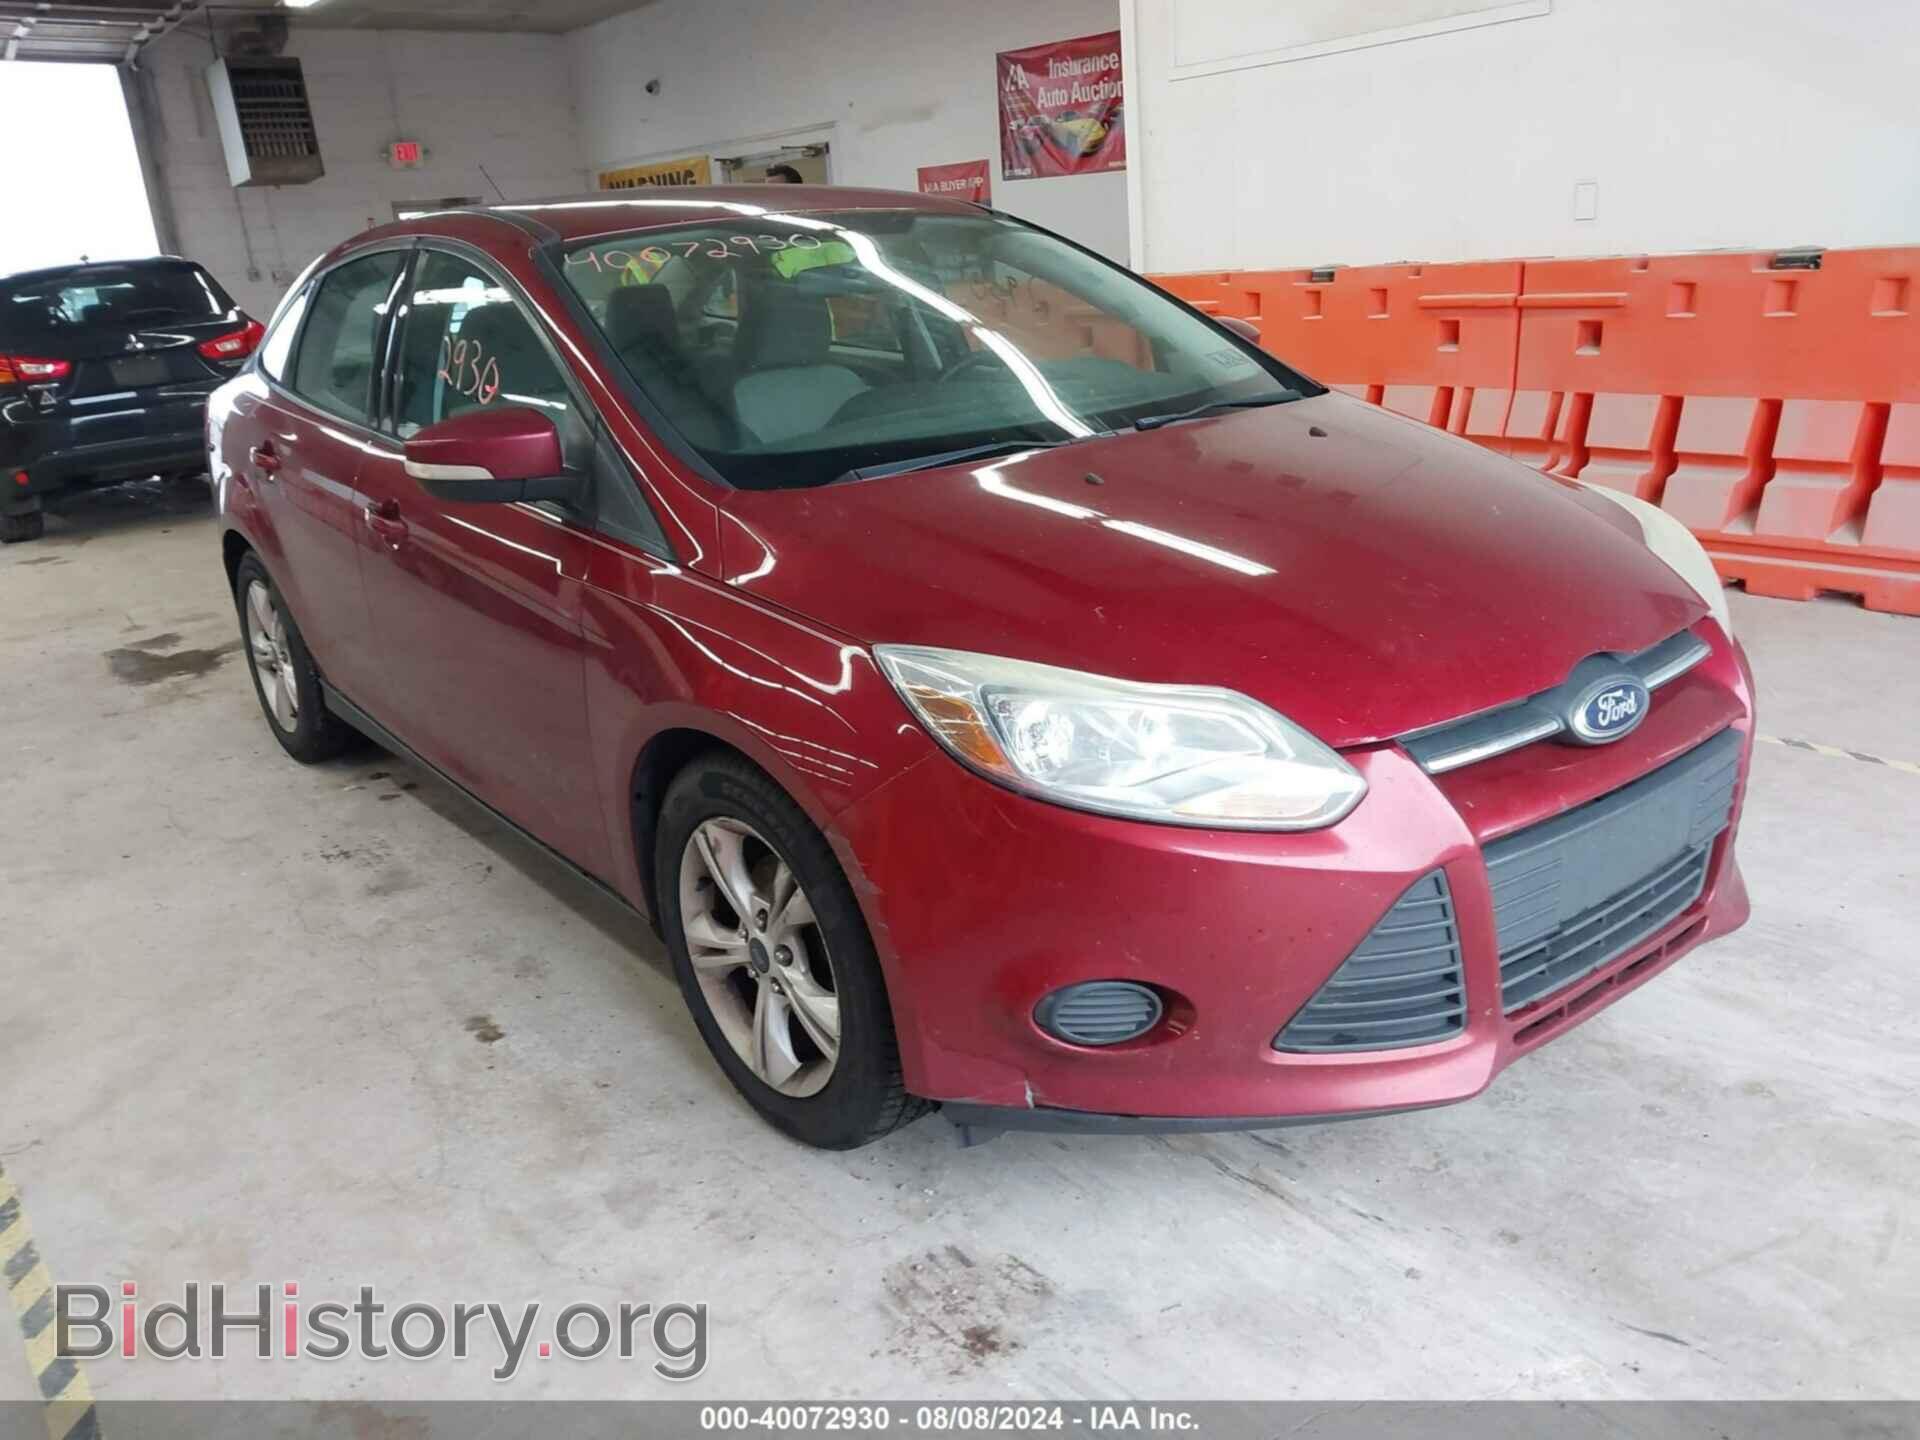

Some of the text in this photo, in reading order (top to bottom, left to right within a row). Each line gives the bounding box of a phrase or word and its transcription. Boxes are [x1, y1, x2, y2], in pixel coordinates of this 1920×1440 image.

[1048, 52, 1120, 80] Insurance
[1036, 86, 1069, 110] Auto
[396, 143, 417, 161] EXIT
[940, 178, 967, 193] BUYER
[563, 233, 821, 274] 40072930
[436, 335, 499, 405] 2930
[1597, 688, 1637, 727] Ford
